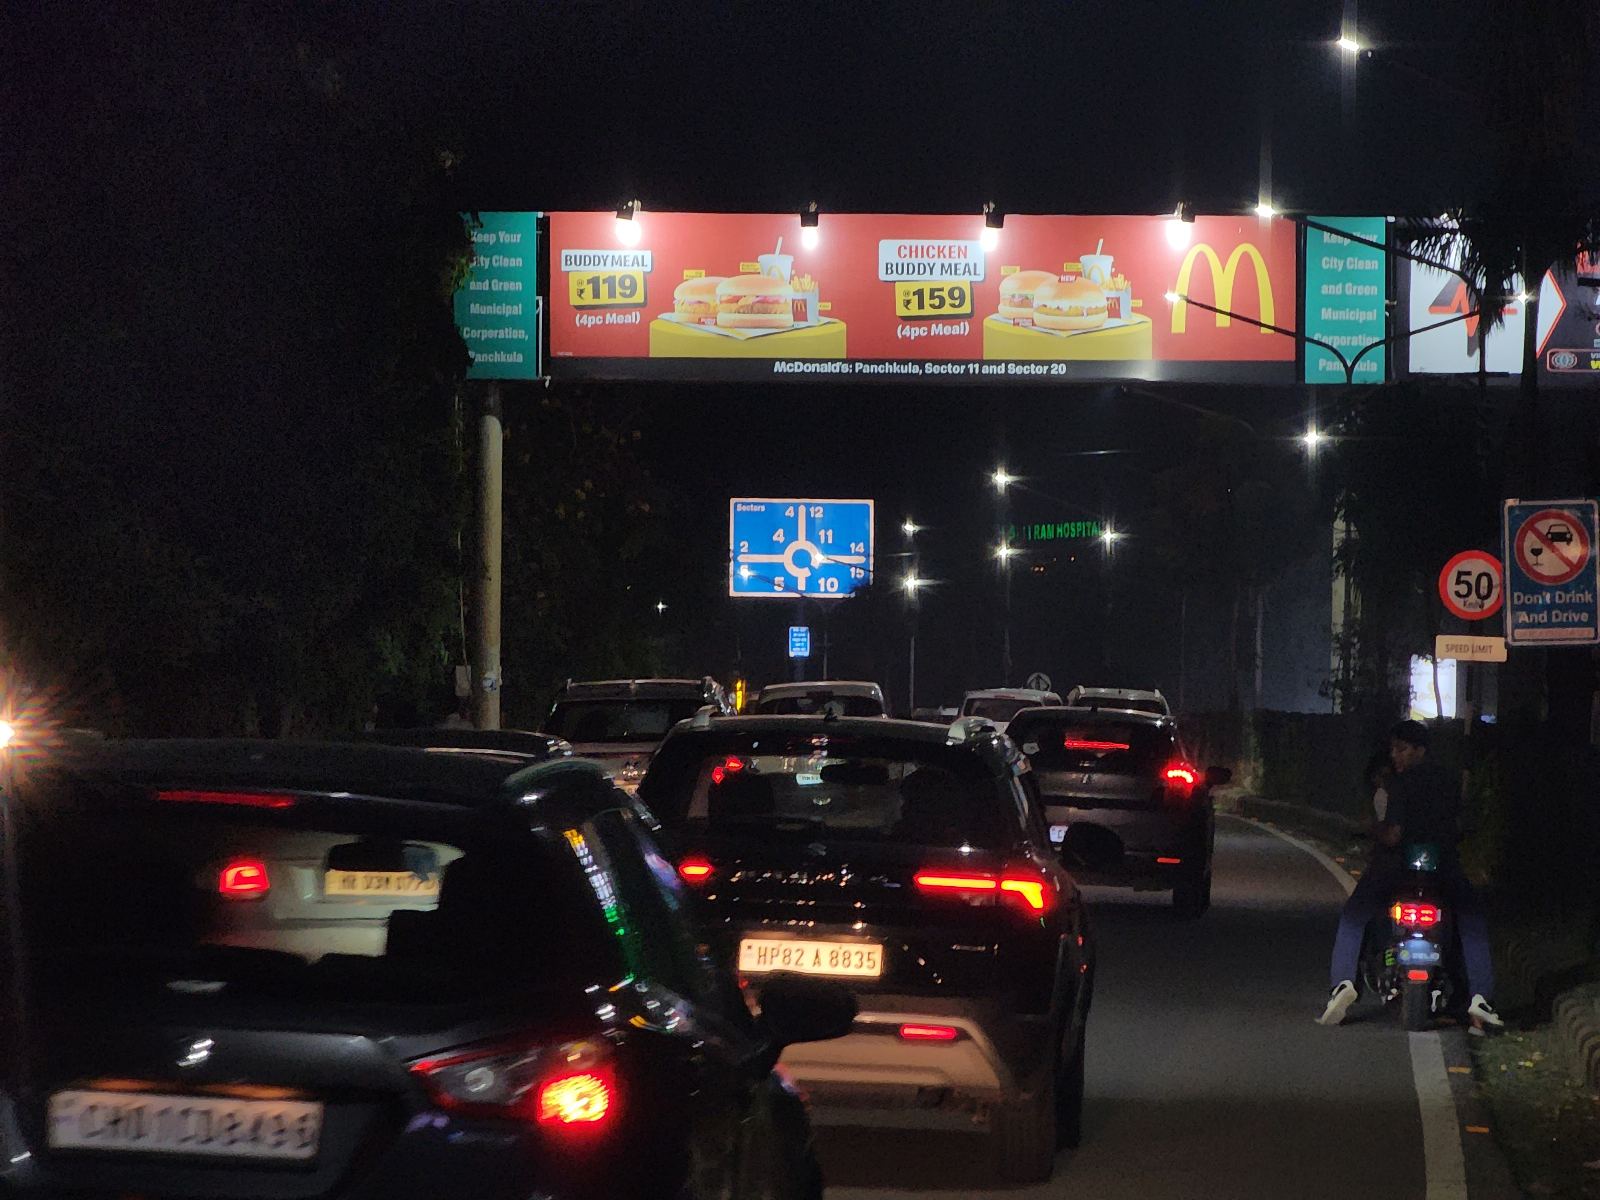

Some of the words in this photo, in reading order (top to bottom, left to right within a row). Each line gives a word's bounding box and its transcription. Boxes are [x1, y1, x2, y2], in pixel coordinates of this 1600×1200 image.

[498, 230, 521, 243] Your
[897, 244, 968, 259] CHICKEN
[491, 254, 523, 268] Clean
[564, 254, 610, 267] BUDDY
[611, 255, 648, 267] MEAL
[1321, 256, 1345, 272] City
[1346, 257, 1379, 270] Clean
[884, 262, 937, 275] BUDDY
[939, 262, 981, 276] MEAL
[491, 278, 523, 292] Green
[1321, 282, 1343, 296] and
[1344, 282, 1378, 296] Green
[469, 303, 522, 317] Municipal
[1321, 307, 1377, 323] Municipal
[575, 313, 604, 328] (4pc
[605, 311, 641, 325] Meal)
[463, 327, 529, 341] Corporation,
[896, 324, 928, 340] (4pc
[930, 321, 969, 336] Meal)
[854, 362, 923, 375] Panchkula,
[924, 362, 966, 375] Sector
[967, 362, 980, 374] 11
[981, 362, 1006, 375] and
[1007, 363, 1049, 375] Sector
[1050, 363, 1067, 375] 20
[736, 503, 766, 512] Sectors
[785, 506, 795, 518] 4
[809, 506, 824, 518] 12
[772, 528, 785, 543] 4
[818, 529, 833, 544] 11
[739, 541, 749, 552] 2
[850, 542, 865, 553] 14
[850, 567, 865, 579] 15
[773, 577, 785, 592] 5
[818, 577, 839, 592] 10
[1454, 570, 1494, 601] 50
[1513, 591, 1551, 605] Don't
[1555, 590, 1593, 605] Drink
[1518, 610, 1548, 624] And
[1551, 610, 1589, 623] Drive
[1445, 644, 1469, 653] SPEED
[1471, 644, 1493, 654] LIMIT
[757, 945, 804, 967] HP82
[812, 947, 822, 968] A
[829, 949, 876, 970] 8835
